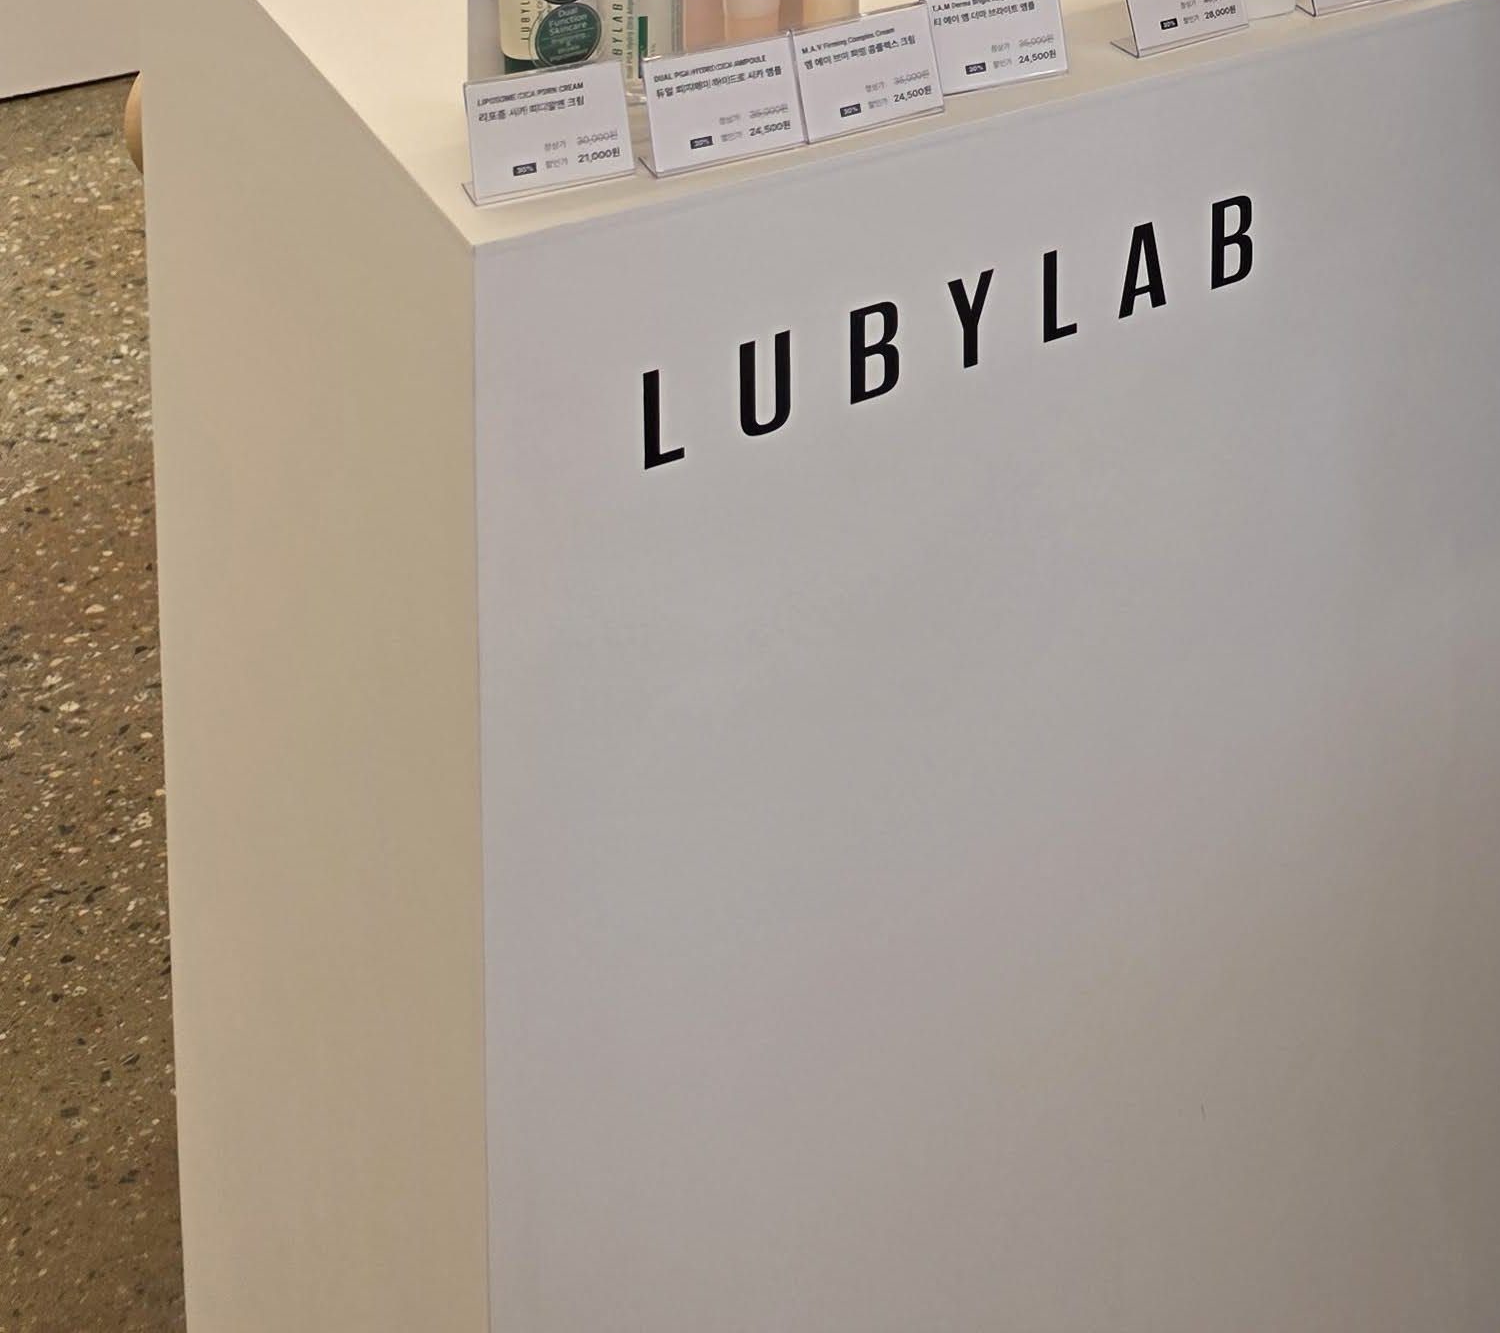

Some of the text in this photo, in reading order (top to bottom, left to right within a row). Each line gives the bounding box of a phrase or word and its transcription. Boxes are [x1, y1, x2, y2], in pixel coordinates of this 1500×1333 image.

[558, 7, 579, 18] Dual
[951, 0, 971, 9] Derma
[1203, 4, 1237, 20] 28,000원
[550, 14, 588, 28] Function
[933, 17, 942, 26] 티
[943, 14, 960, 25] 에이
[971, 9, 987, 20] 더마
[988, 3, 1019, 17] 브라이트
[612, 3, 624, 56] BYLAB
[823, 39, 847, 50] Firming
[848, 32, 875, 44] Complex
[875, 27, 895, 37] Cream
[814, 56, 832, 67] 에이
[833, 51, 849, 63] 브이
[901, 35, 916, 46] 크림
[1018, 49, 1057, 64] 24,500원
[654, 55, 766, 83] DUAL AMPOULE
[558, 82, 584, 93] CREAM
[656, 87, 674, 99] 듀얼
[765, 65, 782, 77] 앰플
[567, 95, 585, 108] 크림
[894, 85, 932, 103] 24,500원
[749, 120, 791, 137] 24,500원
[578, 147, 620, 164] 21,000원
[642, 194, 1255, 470] LUBYLAB
